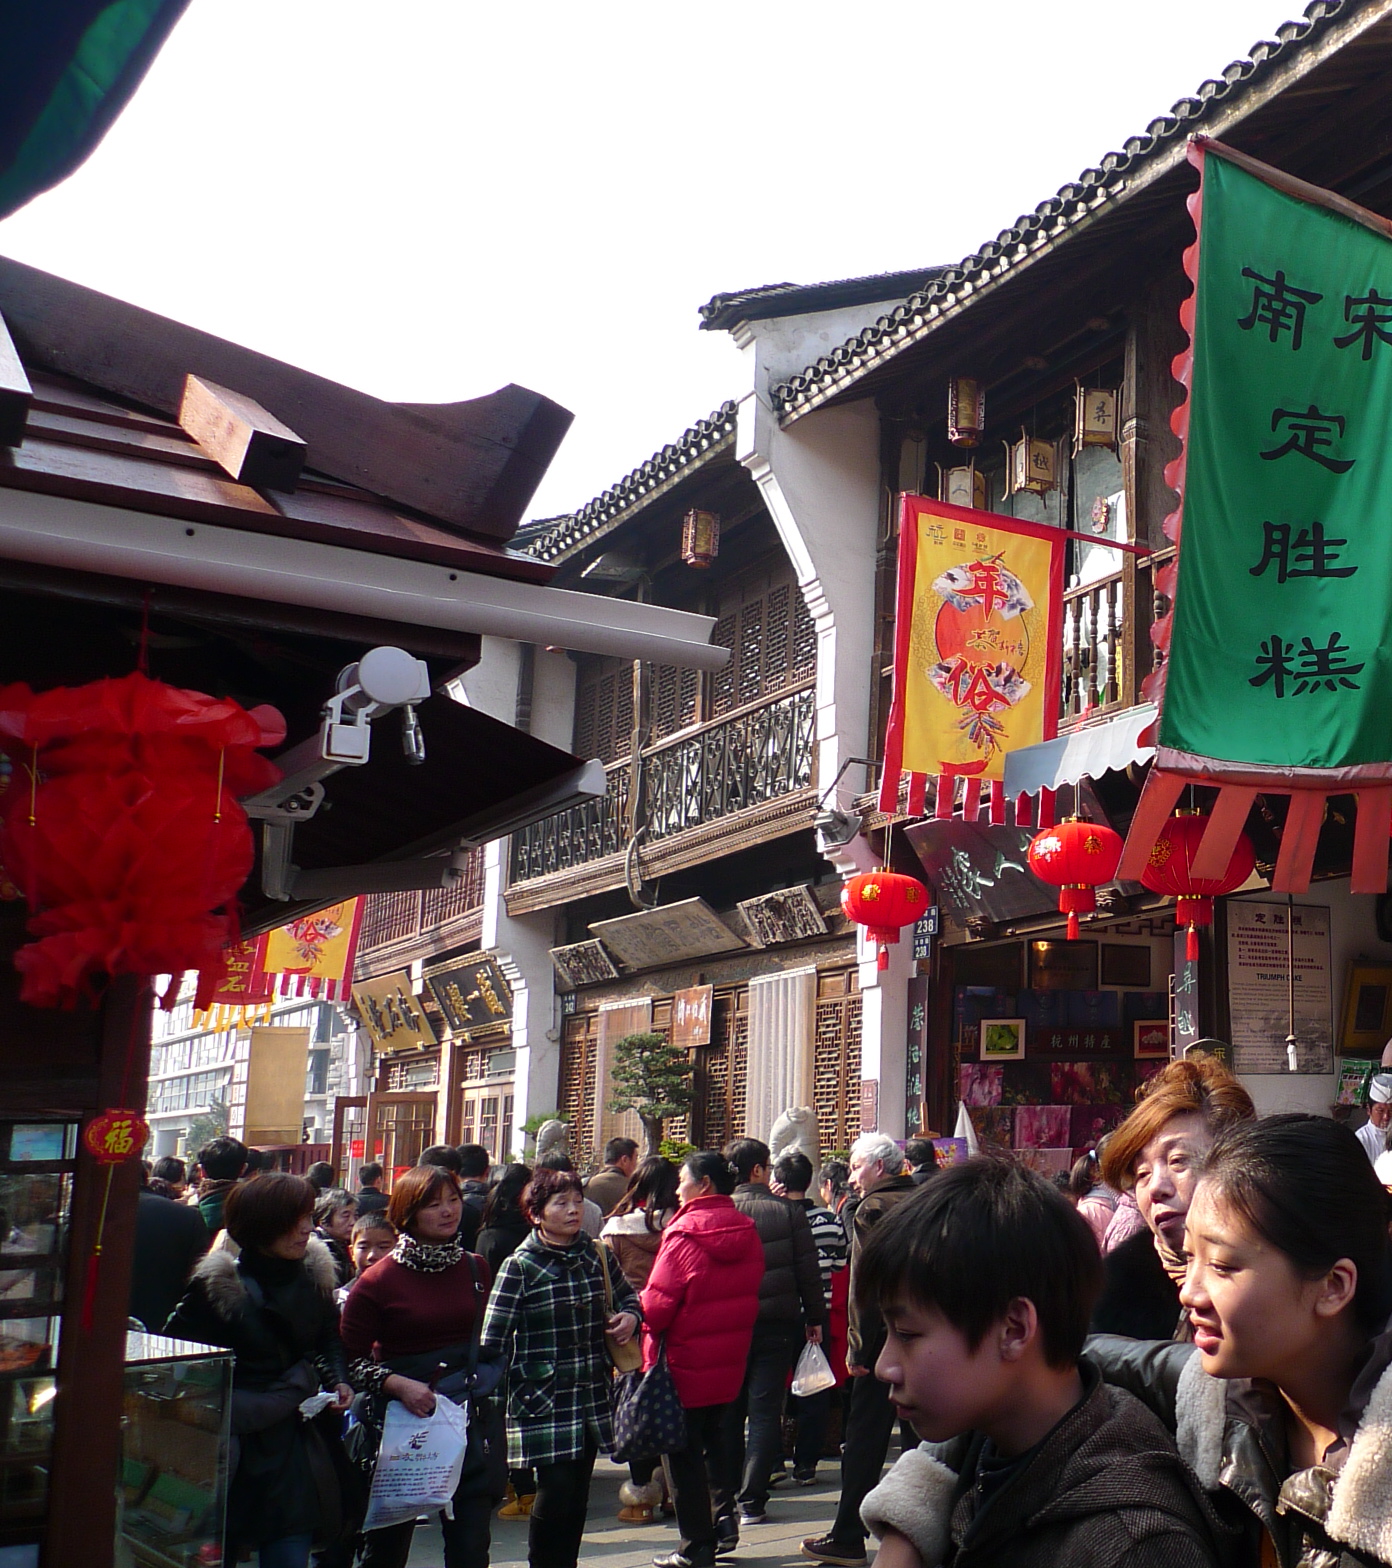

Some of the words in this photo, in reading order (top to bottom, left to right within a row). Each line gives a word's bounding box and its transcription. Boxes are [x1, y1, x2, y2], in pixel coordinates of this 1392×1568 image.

[1249, 405, 1365, 698] 定胜糕
[916, 919, 934, 934] 238
[1256, 973, 1285, 982] TRIUMPH
[104, 1119, 134, 1154] 福
